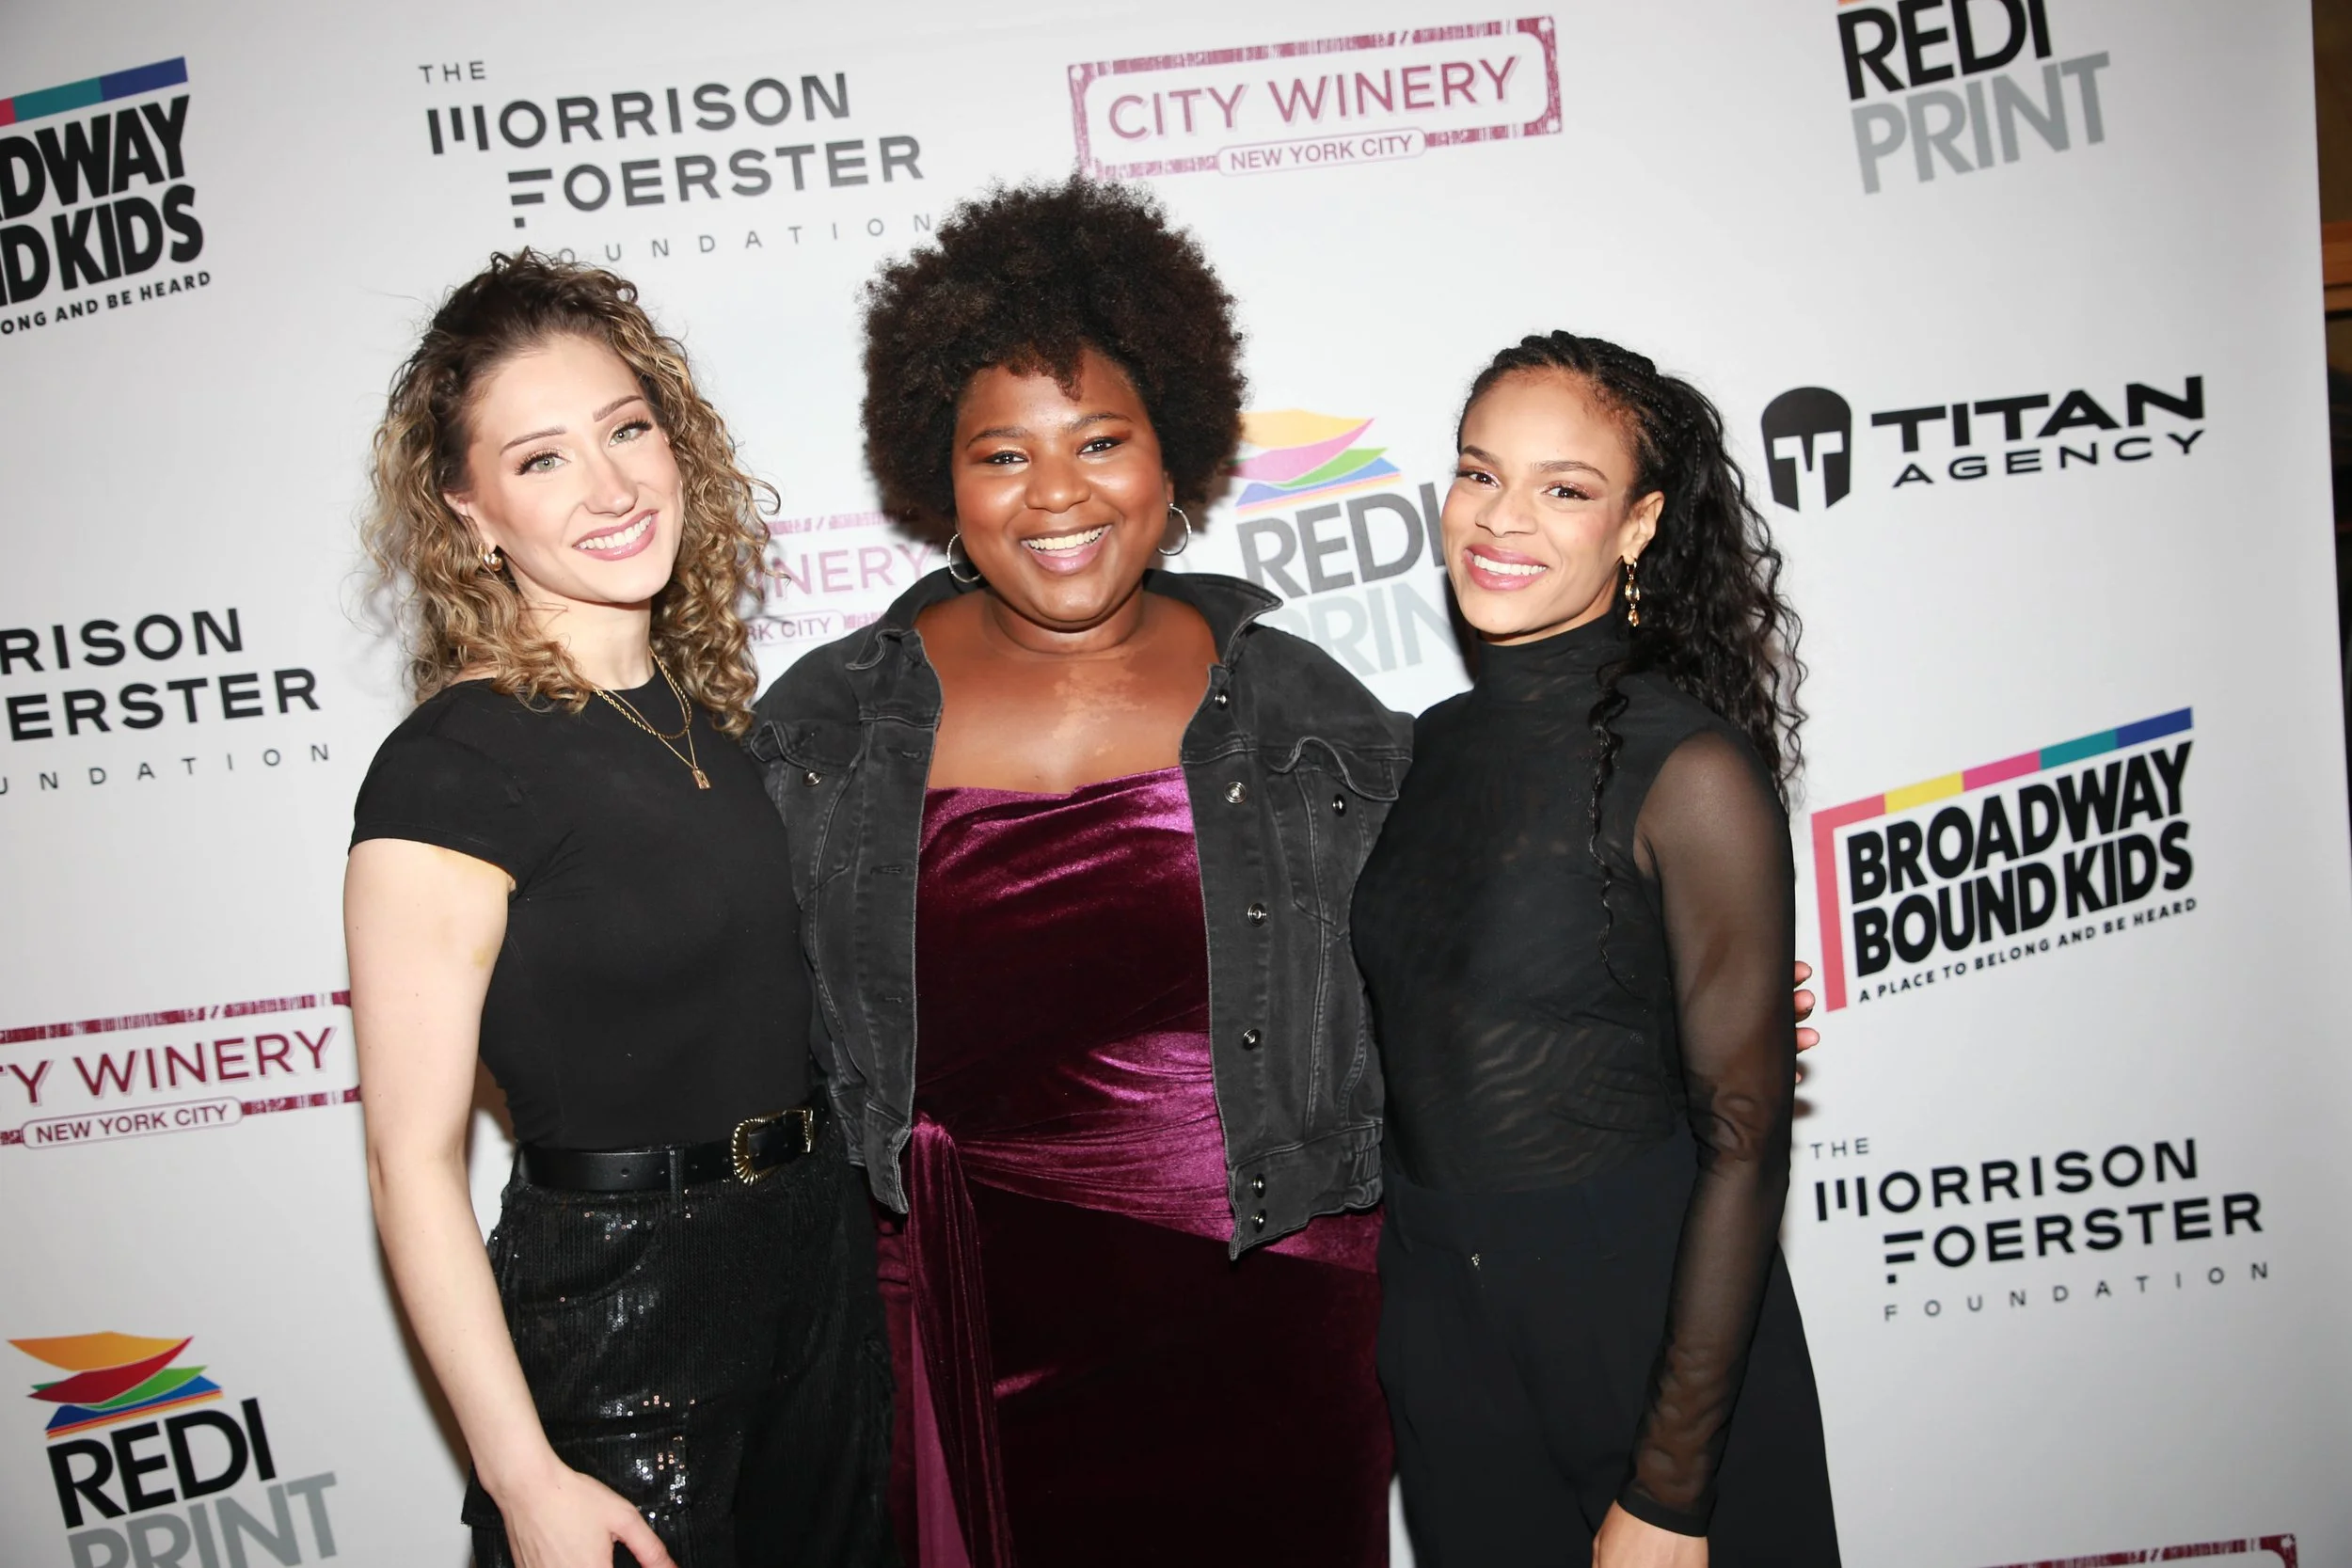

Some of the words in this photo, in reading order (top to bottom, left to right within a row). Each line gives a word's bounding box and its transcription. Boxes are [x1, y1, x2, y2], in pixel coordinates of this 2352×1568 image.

[420, 61, 485, 83] THE
[1836, 0, 2052, 101] REDI
[427, 72, 850, 155] MORRISON
[1109, 83, 1249, 139] CITY
[1267, 55, 1521, 124] WINERY
[1851, 51, 2110, 194] PRINT
[0, 95, 189, 220] DWAY
[508, 135, 924, 229] FOERSTER
[1231, 148, 1282, 170] NEW
[1290, 140, 1356, 165] YORK
[1361, 135, 1413, 157] CITY
[52, 184, 203, 291] KIDS
[558, 213, 930, 264] OUNDATION
[1, 311, 46, 334] ONG
[56, 300, 98, 322] AND
[107, 291, 132, 309] BE
[140, 272, 210, 301] HEARD
[1871, 374, 2204, 452] TITAN
[1892, 429, 2204, 488] AGENCY
[1236, 482, 1447, 599] REDI
[0, 609, 243, 675] RISON
[781, 617, 831, 638] CITY
[6, 668, 321, 741] ERSTER
[1847, 740, 2193, 904] BROADWAY
[1852, 862, 2057, 977] BOUND
[2063, 820, 2194, 919] KIDS
[1859, 990, 1870, 1003] A
[1878, 970, 1934, 998] PLACE
[1943, 962, 1966, 978] TO
[1976, 939, 2050, 970] BELONG
[2058, 927, 2095, 947] AND
[2105, 918, 2125, 932] BE
[2134, 898, 2197, 927] HEARD
[72, 1026, 337, 1100] WINERY
[36, 1120, 92, 1144] NEW
[99, 1110, 167, 1135] YORK
[175, 1104, 228, 1126] CITY
[1810, 1138, 1869, 1160] THE
[1815, 1138, 2197, 1222] MORRISON
[1883, 1192, 2264, 1284] FOERSTER
[1884, 1262, 2267, 1322] FOUNDATION
[46, 1397, 276, 1529] REDI
[68, 1471, 337, 1568] PRINT
